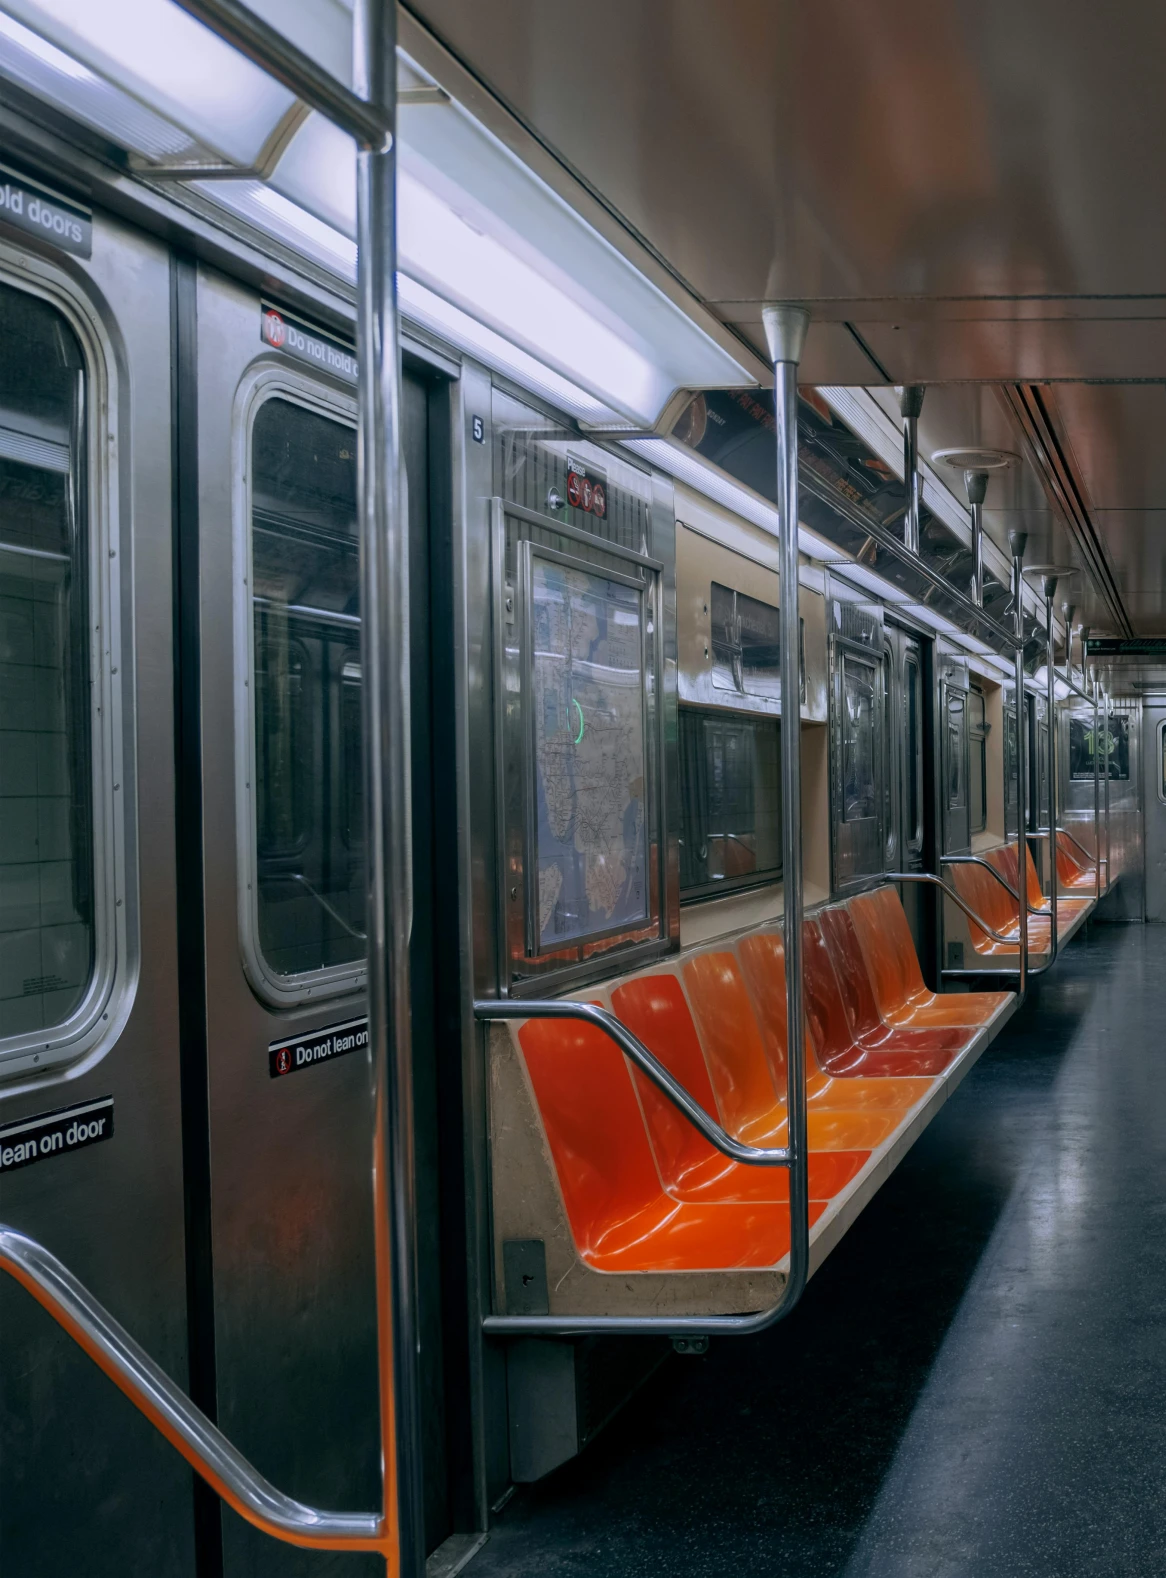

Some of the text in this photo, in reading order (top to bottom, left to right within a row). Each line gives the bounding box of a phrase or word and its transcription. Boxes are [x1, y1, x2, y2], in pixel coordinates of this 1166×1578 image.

[28, 200, 82, 243] doors
[288, 326, 305, 350] Do
[307, 341, 325, 361] not
[328, 345, 351, 374] hold
[474, 418, 482, 439] 5
[567, 458, 586, 477] Please
[296, 1030, 368, 1065] Do not lean on
[0, 1118, 106, 1168] lean on door
